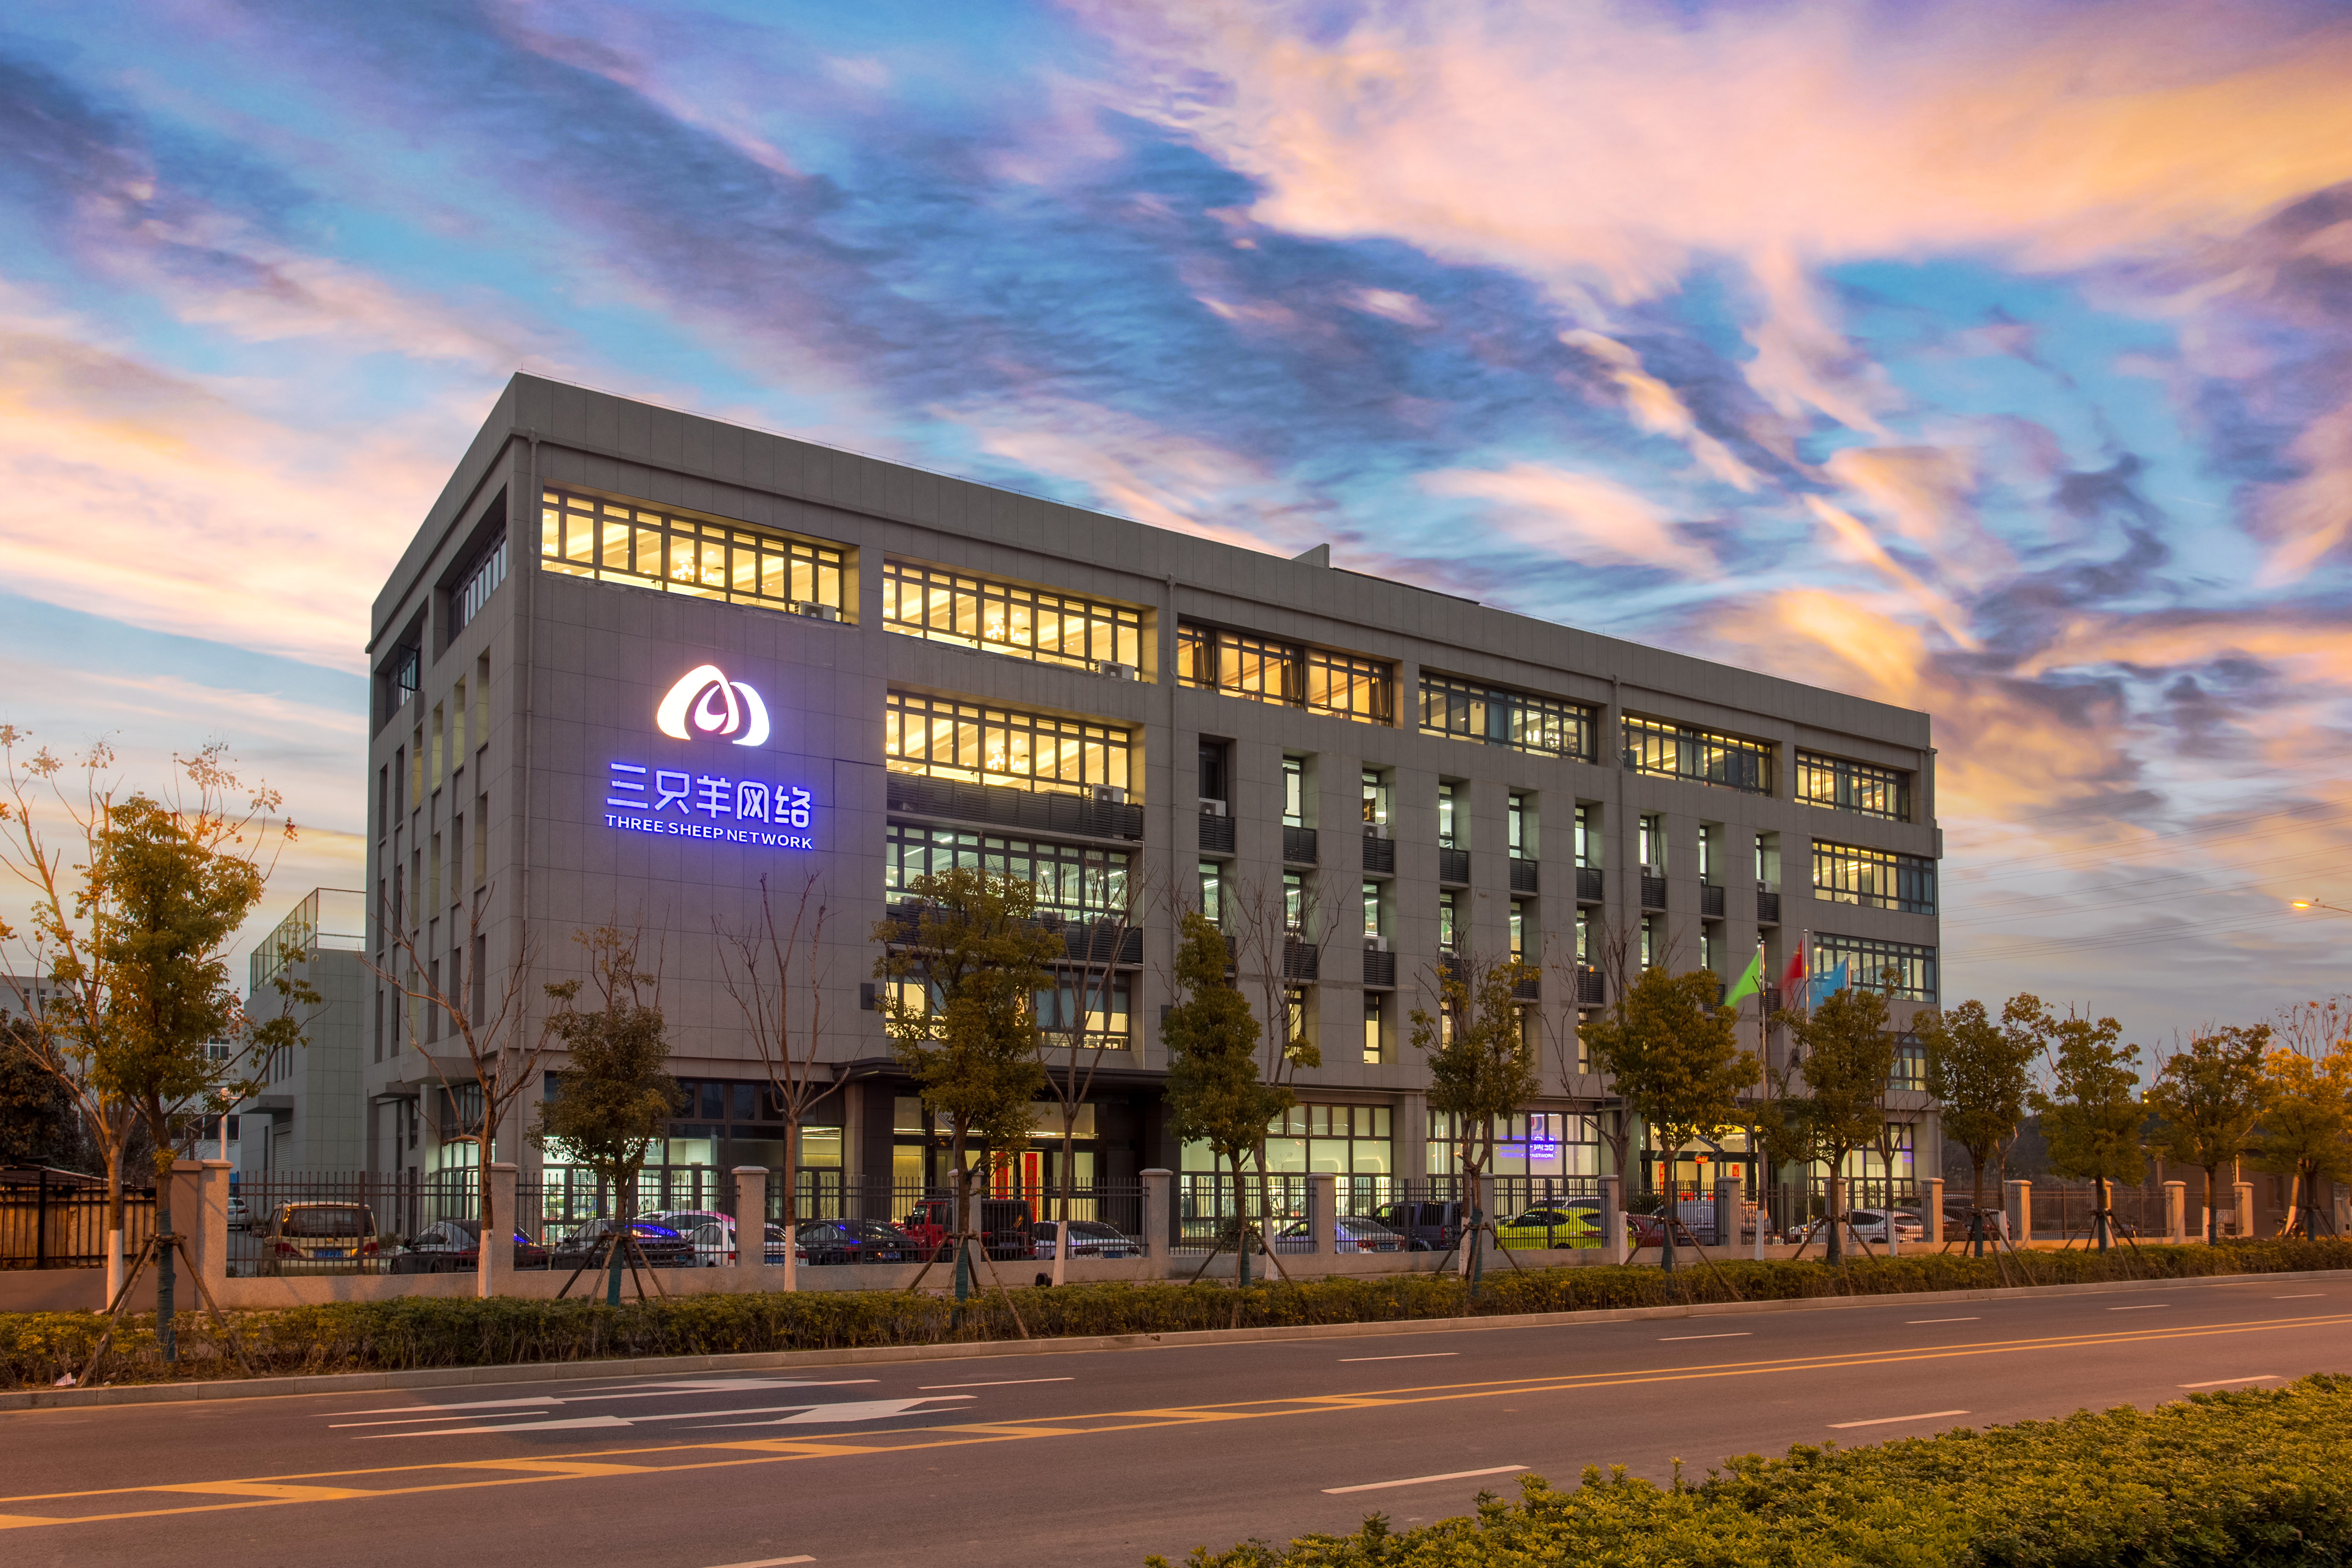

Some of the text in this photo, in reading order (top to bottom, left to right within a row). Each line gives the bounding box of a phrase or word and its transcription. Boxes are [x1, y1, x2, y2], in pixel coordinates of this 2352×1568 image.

[607, 763, 811, 828] 三只羊网络
[605, 814, 813, 849] THREE SHEEP NETWORK
